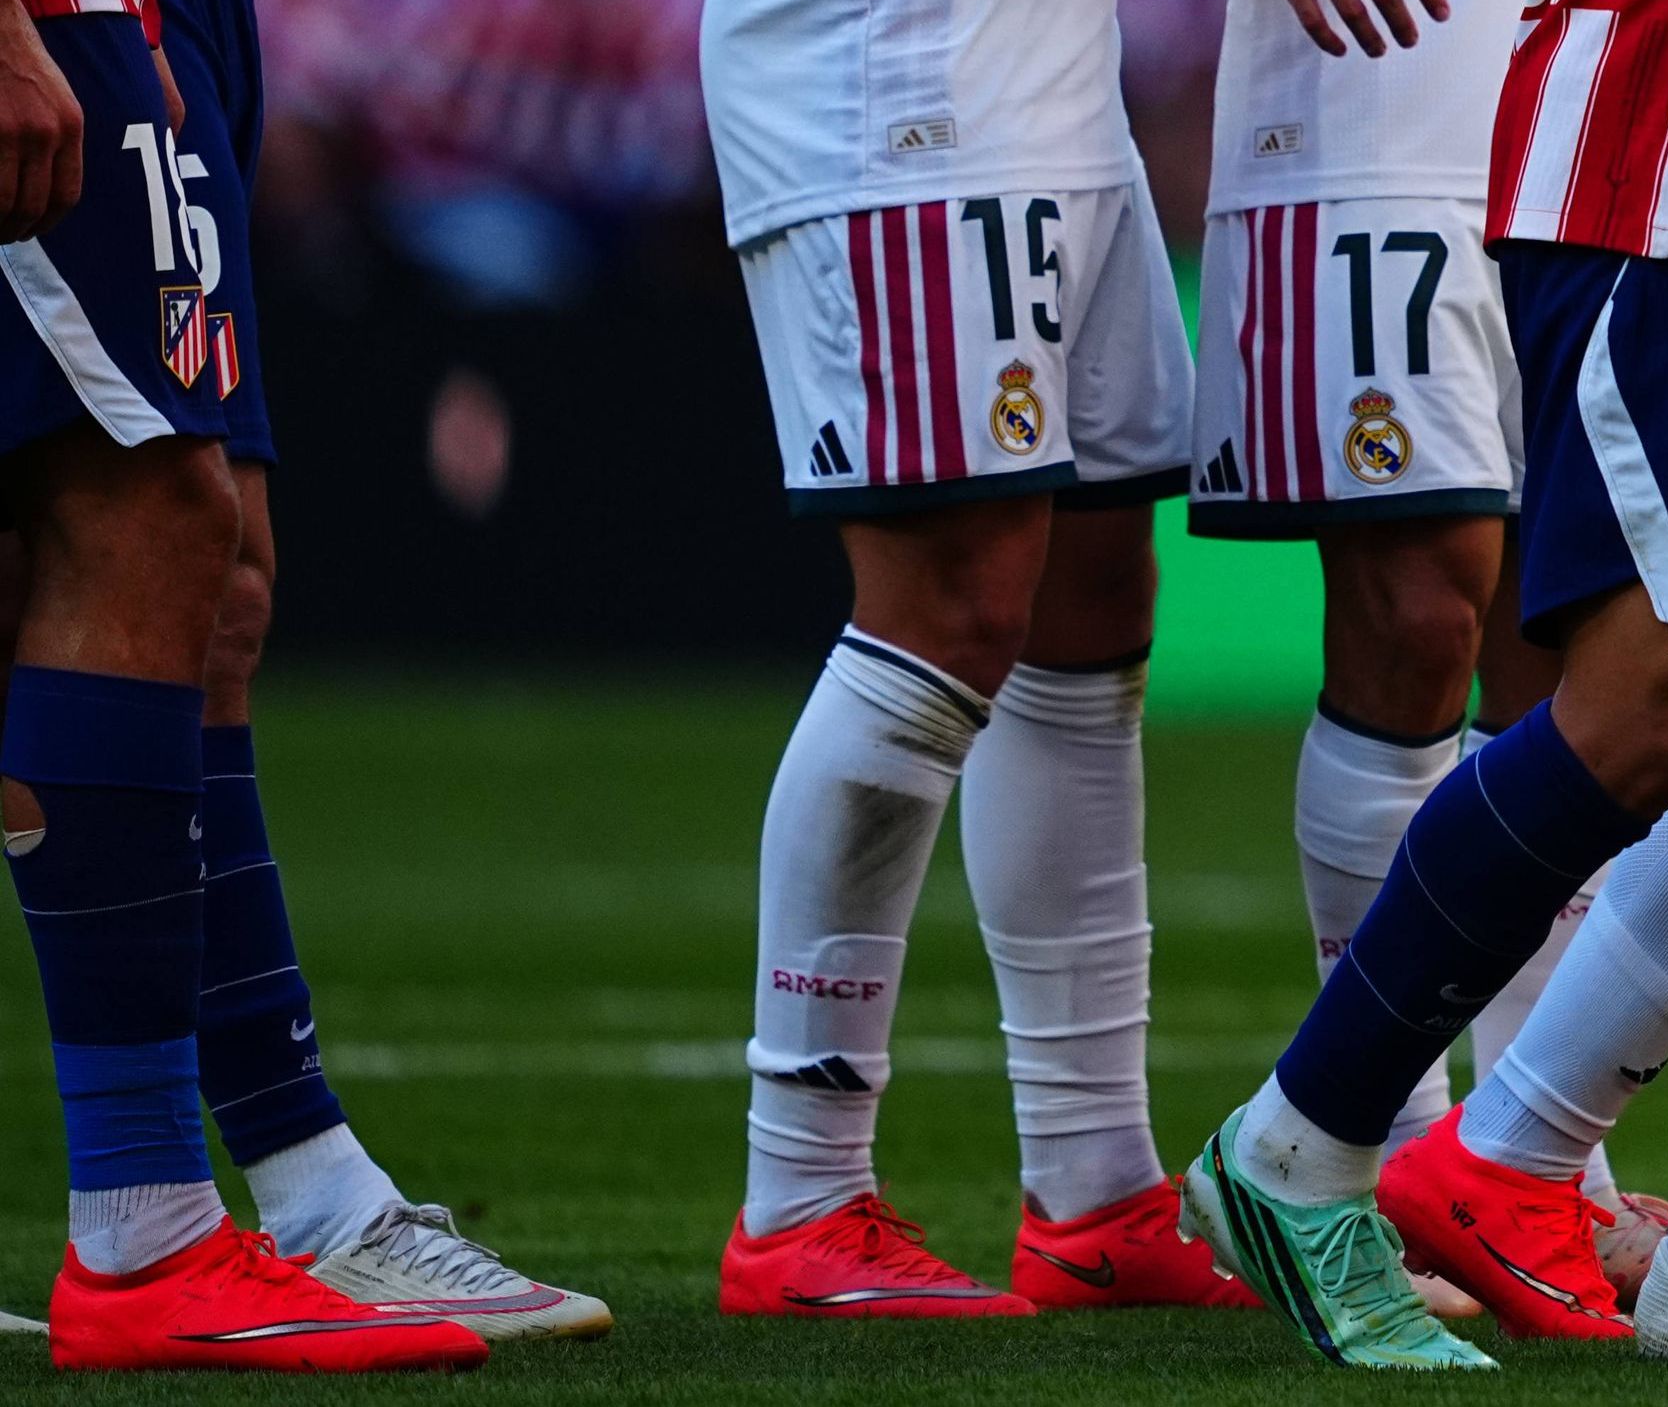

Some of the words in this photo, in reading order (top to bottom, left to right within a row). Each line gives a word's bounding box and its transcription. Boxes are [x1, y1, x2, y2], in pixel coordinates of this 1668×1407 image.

[961, 197, 1062, 344] 15
[1331, 230, 1450, 377] 17
[773, 969, 885, 1002] RMCF
